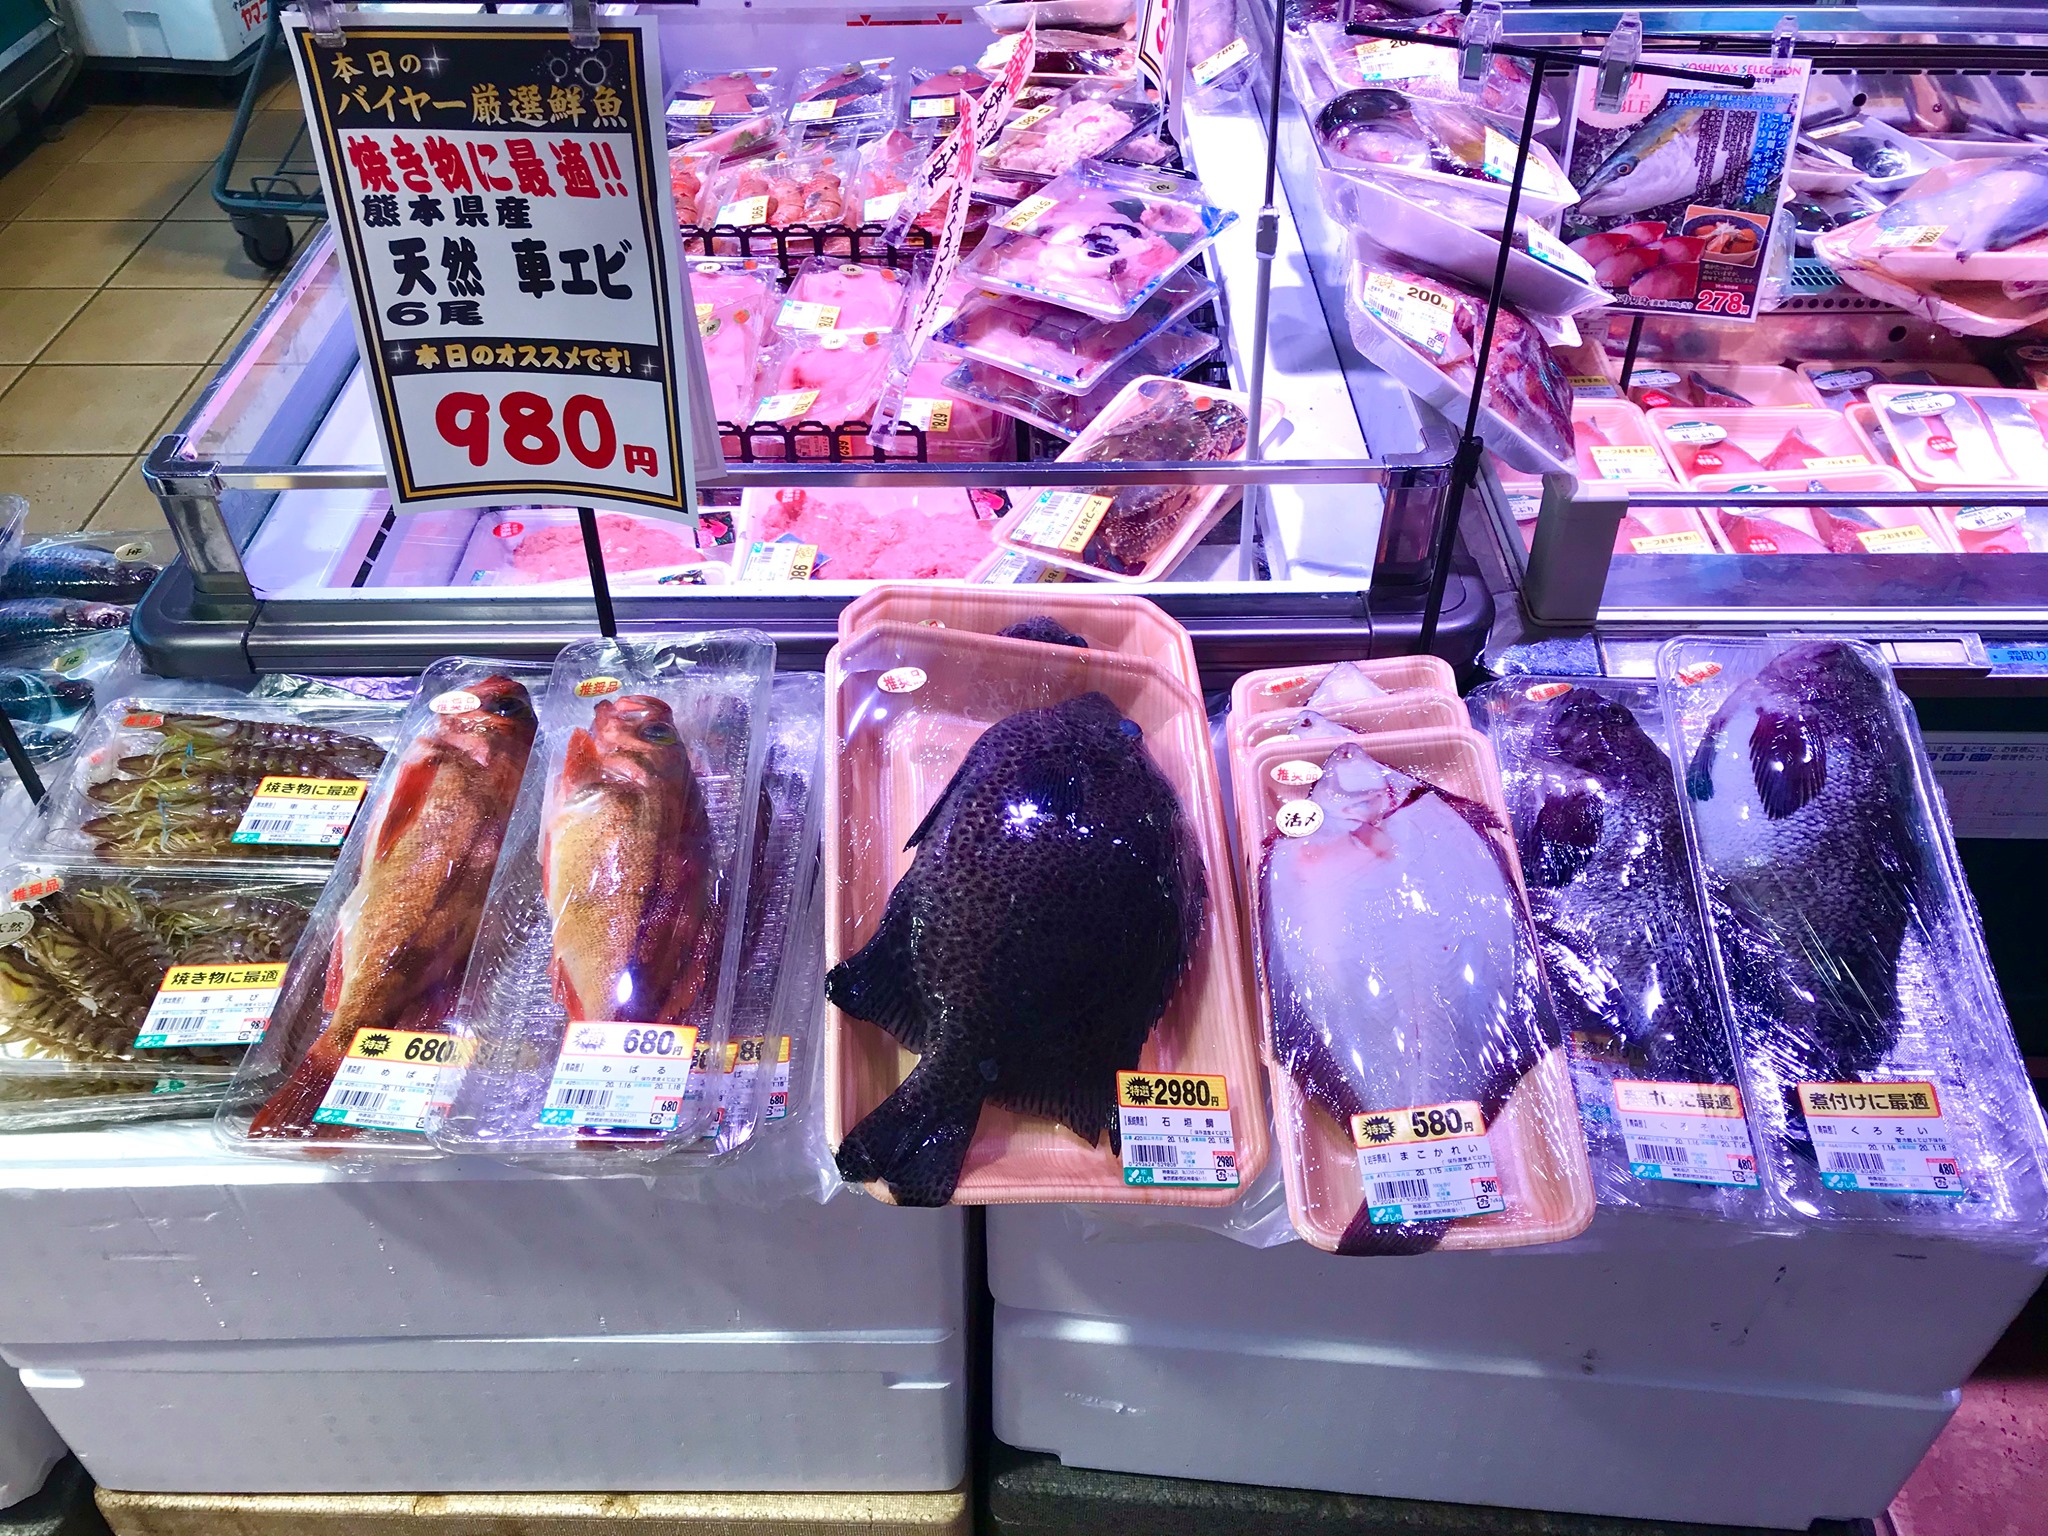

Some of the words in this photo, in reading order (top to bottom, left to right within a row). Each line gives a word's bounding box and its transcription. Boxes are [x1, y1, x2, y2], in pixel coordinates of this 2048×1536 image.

[332, 51, 421, 82] 本日の
[337, 84, 629, 128] バイヤー厳選鮮魚
[347, 135, 628, 198] 焼き物に最適!!
[363, 197, 532, 229] 熊本県産
[388, 238, 484, 297] 天然
[511, 239, 633, 300] 車エビ
[387, 301, 484, 327] 6尾
[1696, 290, 1750, 315] 278円
[415, 343, 631, 374] 本日のオススメです!
[435, 392, 659, 477] 980円
[580, 680, 619, 695] 推奨品
[264, 782, 359, 796] 焼き物に最適
[13, 879, 59, 902] 推奨品
[171, 970, 279, 984] 焼き物に最適
[623, 1028, 683, 1056] 680円
[602, 1065, 666, 1075] めばる
[1130, 1085, 1149, 1097] 特選
[1154, 1078, 1219, 1106] 2980円
[1810, 1092, 1930, 1111] 煮付けに最適
[661, 1101, 678, 1112] 680
[1367, 1122, 1390, 1135] 特選
[1412, 1108, 1474, 1137] 580円
[1851, 1126, 1928, 1136] くろそい
[1217, 1156, 1234, 1167] 2980
[1400, 1144, 1478, 1160] まこかれい
[1738, 1159, 1752, 1170] 480
[1939, 1164, 1955, 1175] 480
[1481, 1180, 1497, 1193] 580
